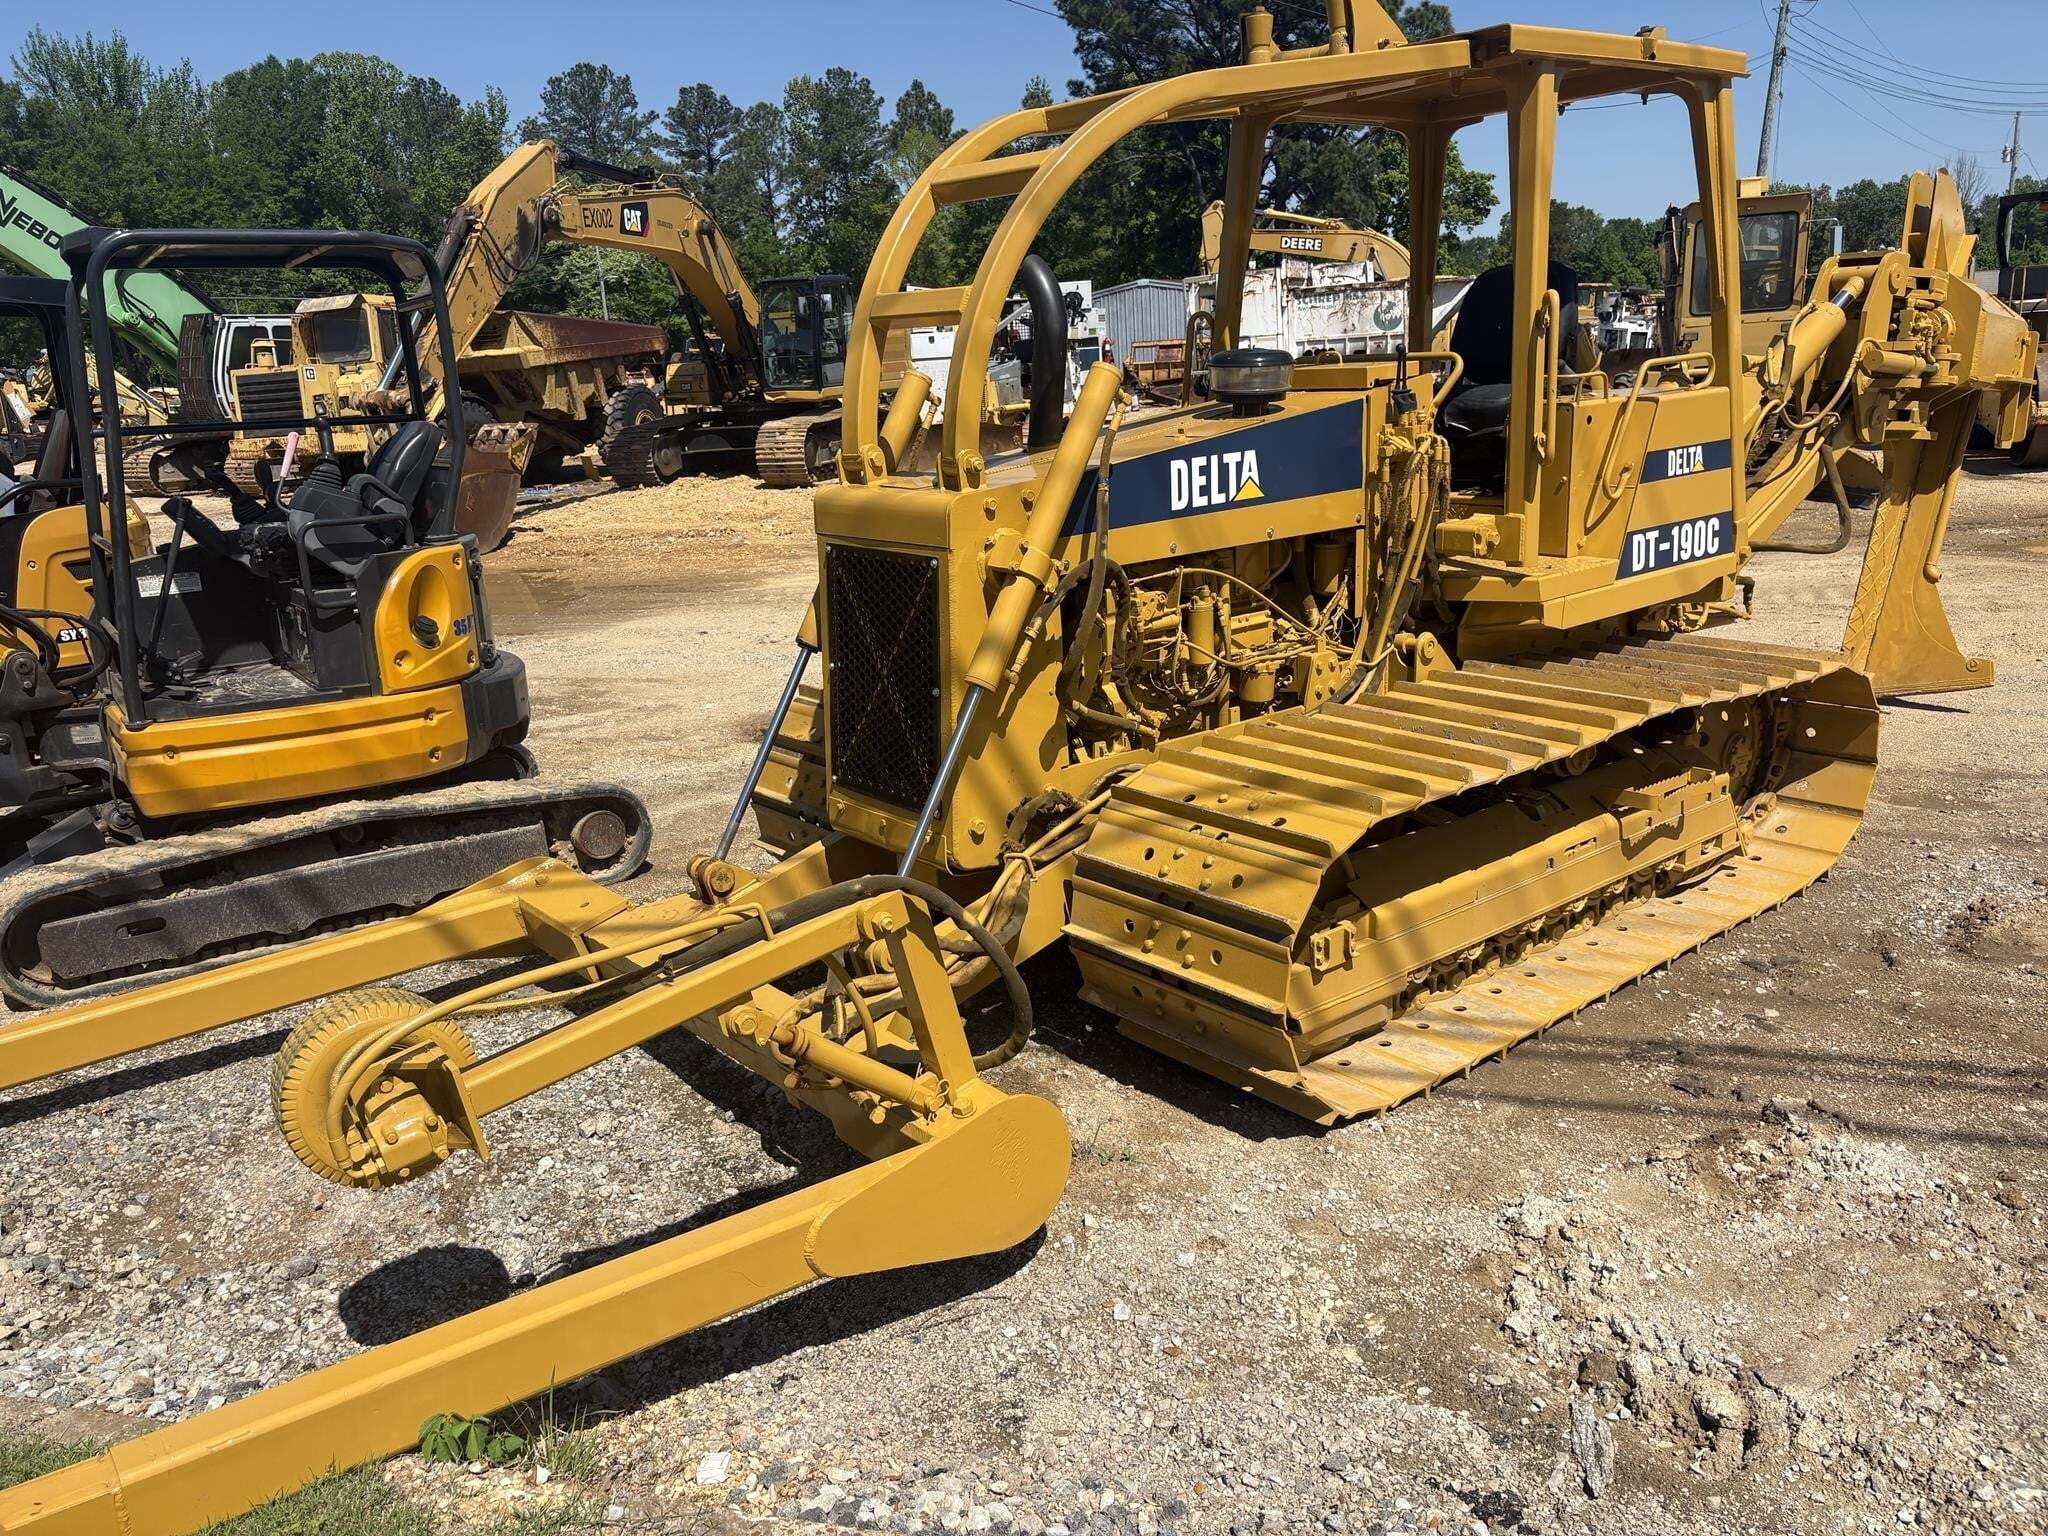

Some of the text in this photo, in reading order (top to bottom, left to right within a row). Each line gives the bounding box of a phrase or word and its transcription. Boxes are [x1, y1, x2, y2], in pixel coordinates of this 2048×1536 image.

[582, 207, 614, 229] EX002
[623, 208, 643, 232] CAT
[1281, 236, 1322, 250] DEERE
[1668, 445, 1703, 477] DELTA
[1170, 450, 1262, 511] DELTA
[1632, 517, 1720, 573] DT-190C
